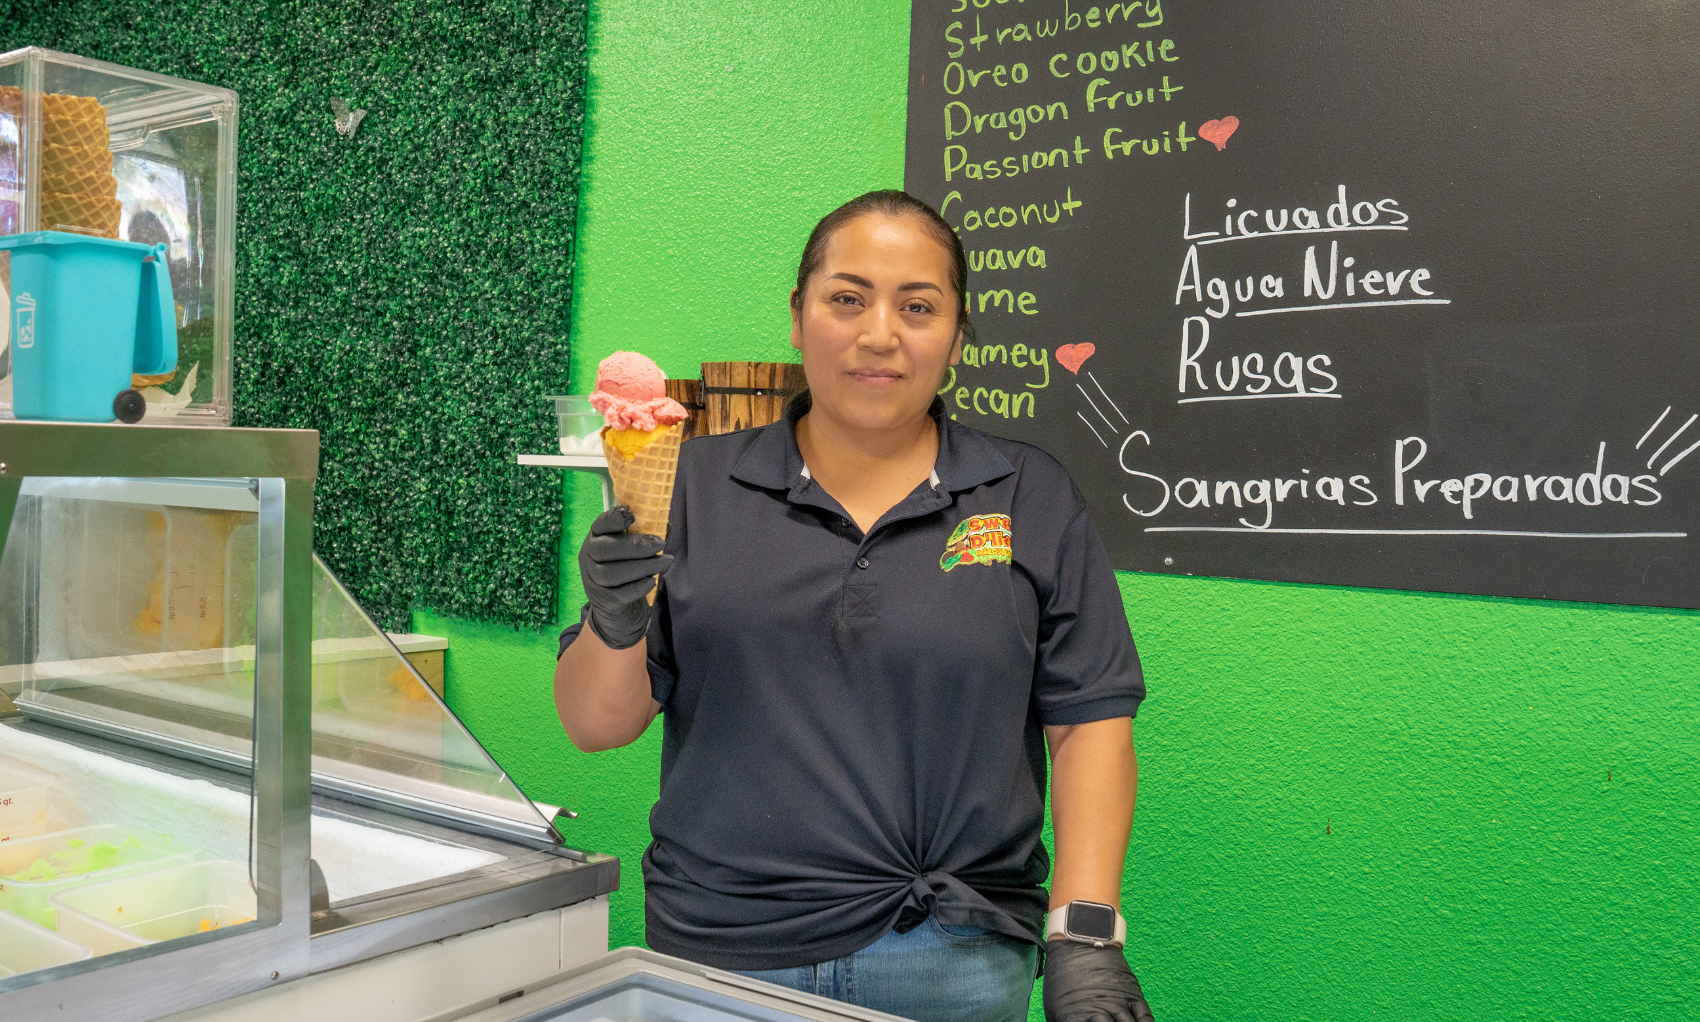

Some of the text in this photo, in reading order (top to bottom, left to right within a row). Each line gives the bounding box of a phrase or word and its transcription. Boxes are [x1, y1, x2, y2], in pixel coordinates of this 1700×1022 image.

[944, 0, 1164, 59] Strawberry
[944, 38, 1179, 95] Oreo cookie
[944, 76, 1184, 141] Dragon fruit
[944, 121, 1197, 182] Passiont fruit
[940, 187, 1083, 234] Caconut
[1184, 184, 1409, 240] Licuados
[964, 246, 1047, 272] uava
[1175, 240, 1435, 318] Agua Nieve
[965, 288, 1039, 315] ime
[961, 343, 1050, 389] amey
[1178, 315, 1338, 393] Rusas
[1118, 430, 1663, 529] Sangrias Preparadas
